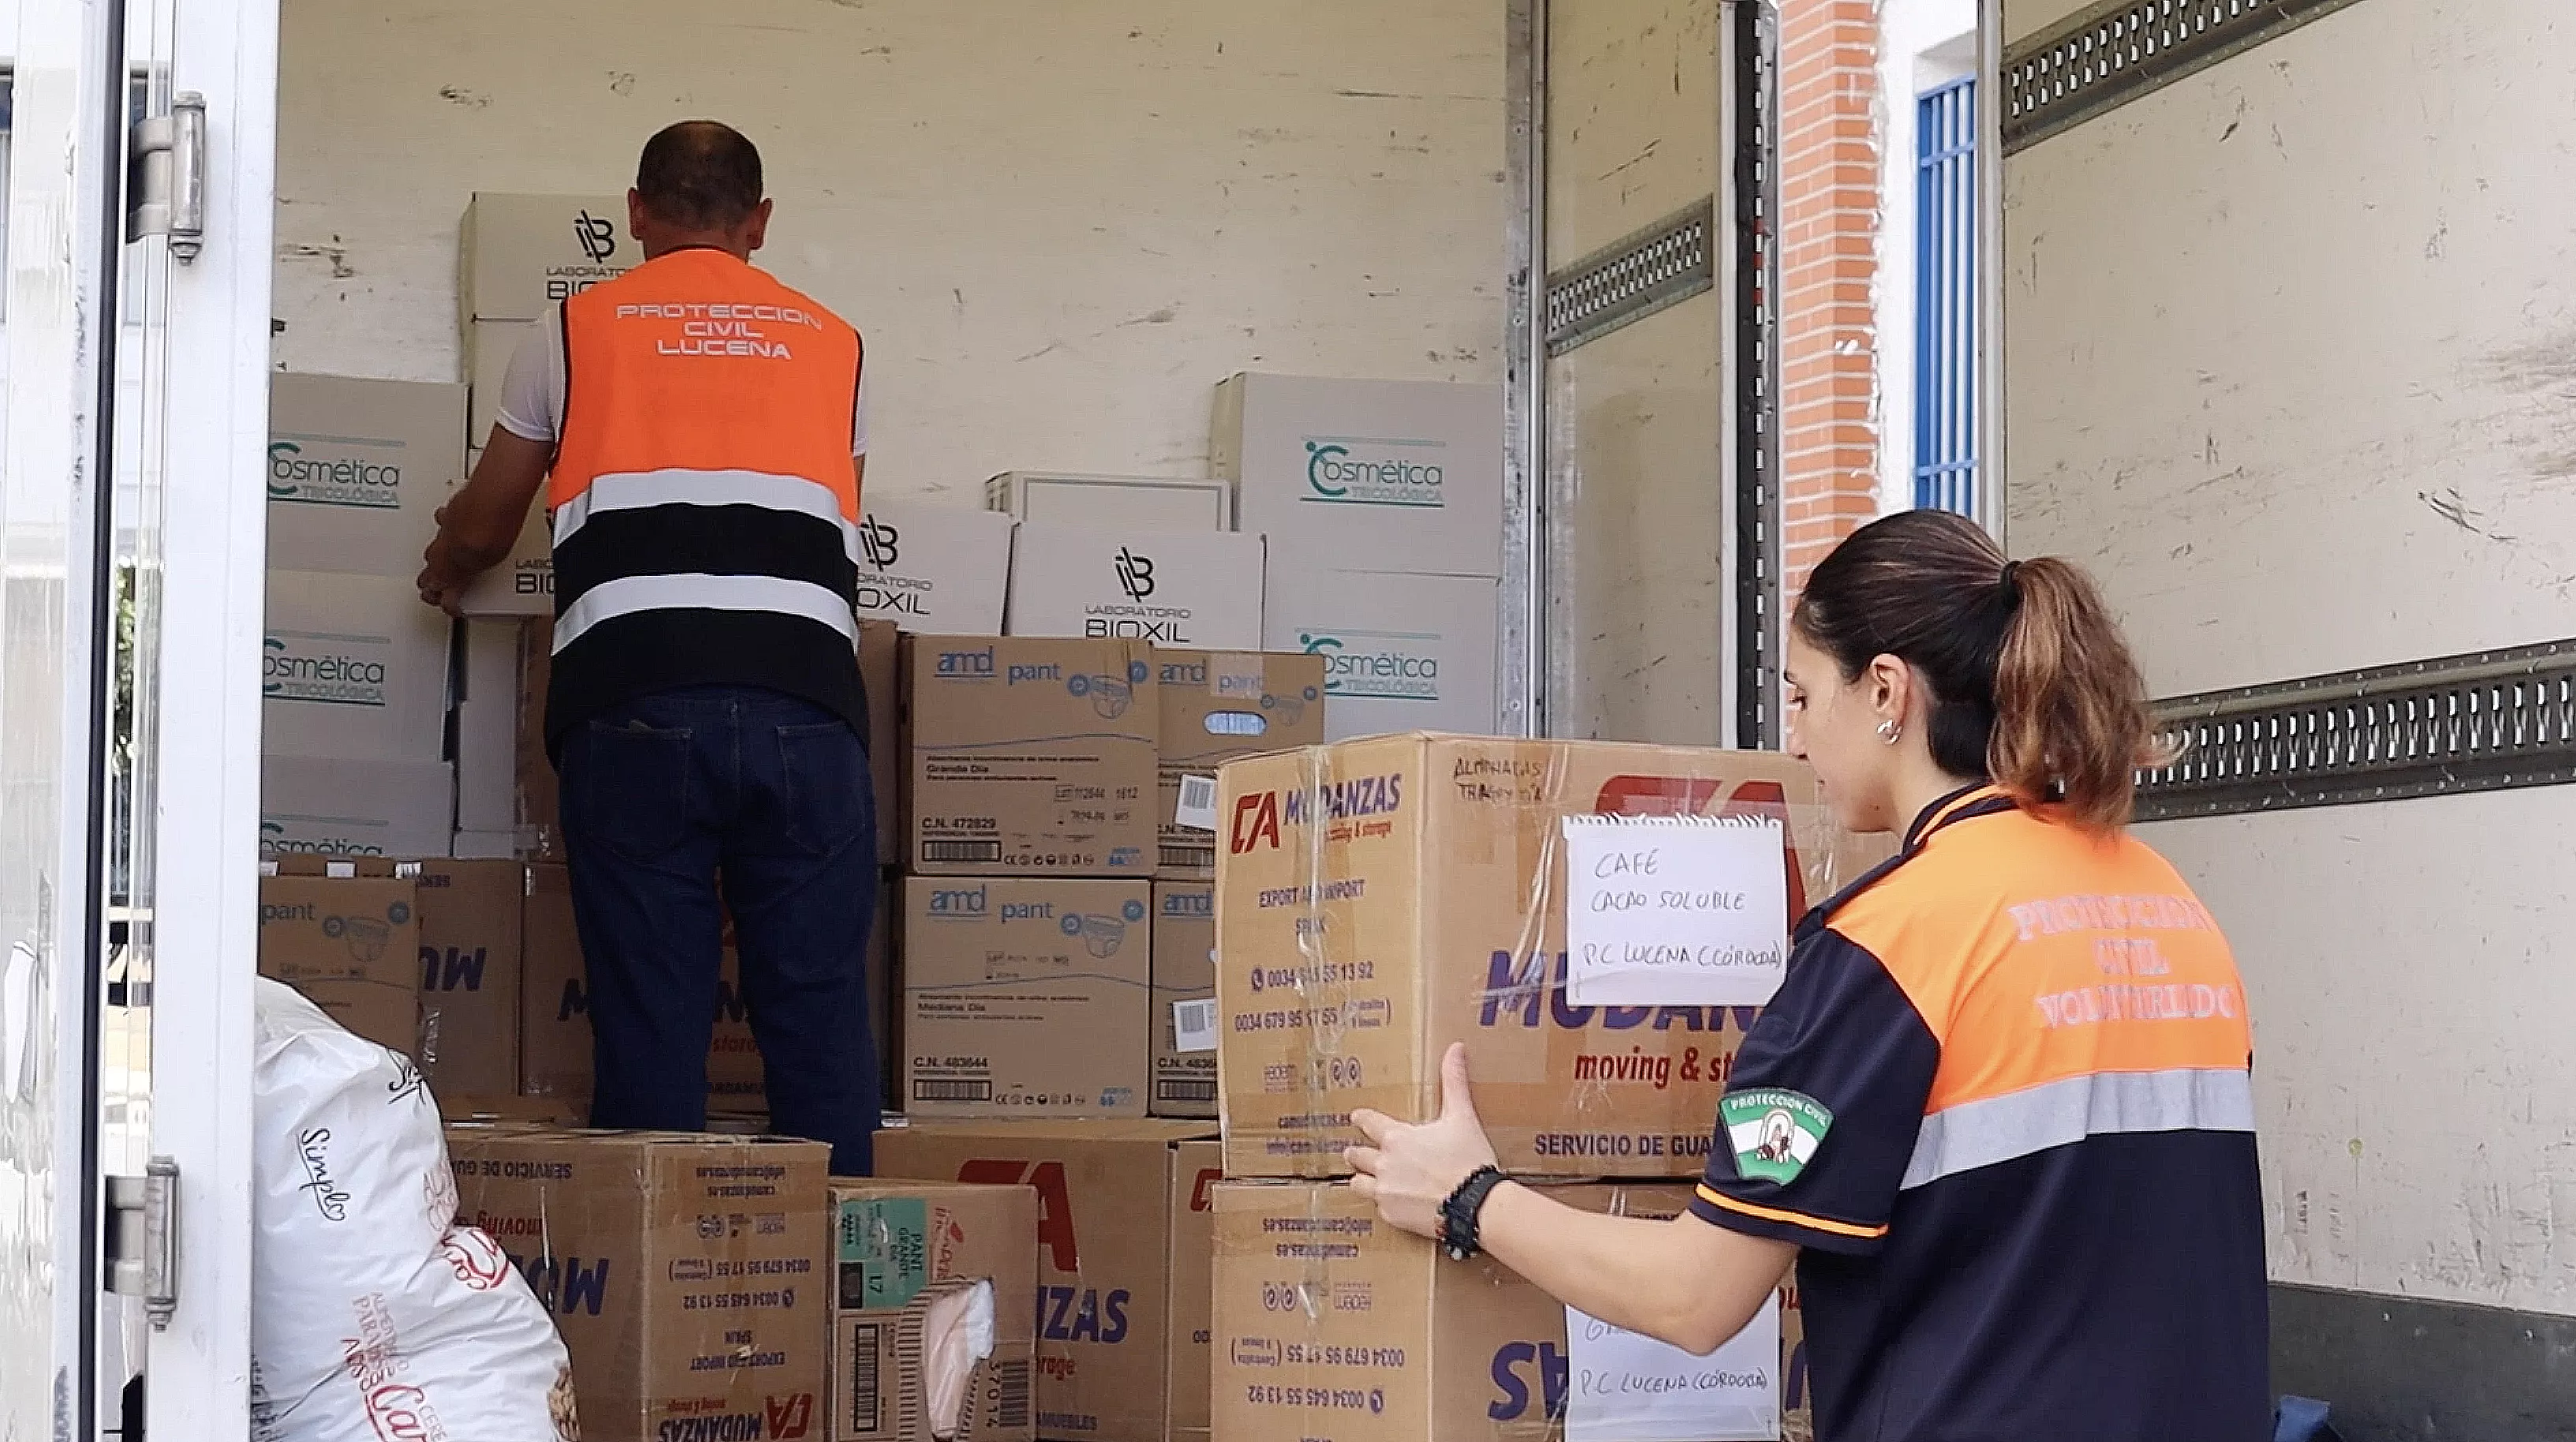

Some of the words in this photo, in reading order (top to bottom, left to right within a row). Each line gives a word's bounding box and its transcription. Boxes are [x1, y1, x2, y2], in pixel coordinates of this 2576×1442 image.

[614, 304, 823, 331] PROTECCION
[684, 321, 764, 338] CIVIL
[656, 339, 793, 360] LUCENA
[1305, 441, 1443, 496] Cosmética
[1085, 605, 1191, 619] LABORATORIO
[1085, 619, 1190, 642] BIOXIL
[1007, 661, 1062, 685] pant
[1594, 848, 1659, 879] CAFÉ
[1591, 889, 1648, 913] CACAO
[1657, 890, 1746, 910] SOLUBLE
[1000, 902, 1055, 924] pant
[1623, 941, 1692, 966] LUCENA
[1341, 962, 1356, 981] 13
[1358, 960, 1374, 979] 92
[1574, 1045, 1671, 1090] moving
[1680, 1048, 1701, 1082] &
[1535, 1134, 1631, 1157] SERVICIO
[1638, 1134, 1664, 1157] DE
[481, 1161, 500, 1178] DE
[505, 1163, 573, 1180] SERVICIO
[910, 1233, 923, 1272] PANT
[1286, 1344, 1303, 1362] 55
[1325, 1347, 1342, 1364] 95
[1345, 1347, 1369, 1365] 679
[1372, 1348, 1405, 1366] 0034
[1620, 1372, 1688, 1394] LUCENA
[1248, 1385, 1263, 1403] 92
[1267, 1386, 1281, 1403] 13
[1286, 1387, 1302, 1406] 55
[1306, 1388, 1330, 1407] 645
[1332, 1389, 1365, 1408] 0034
